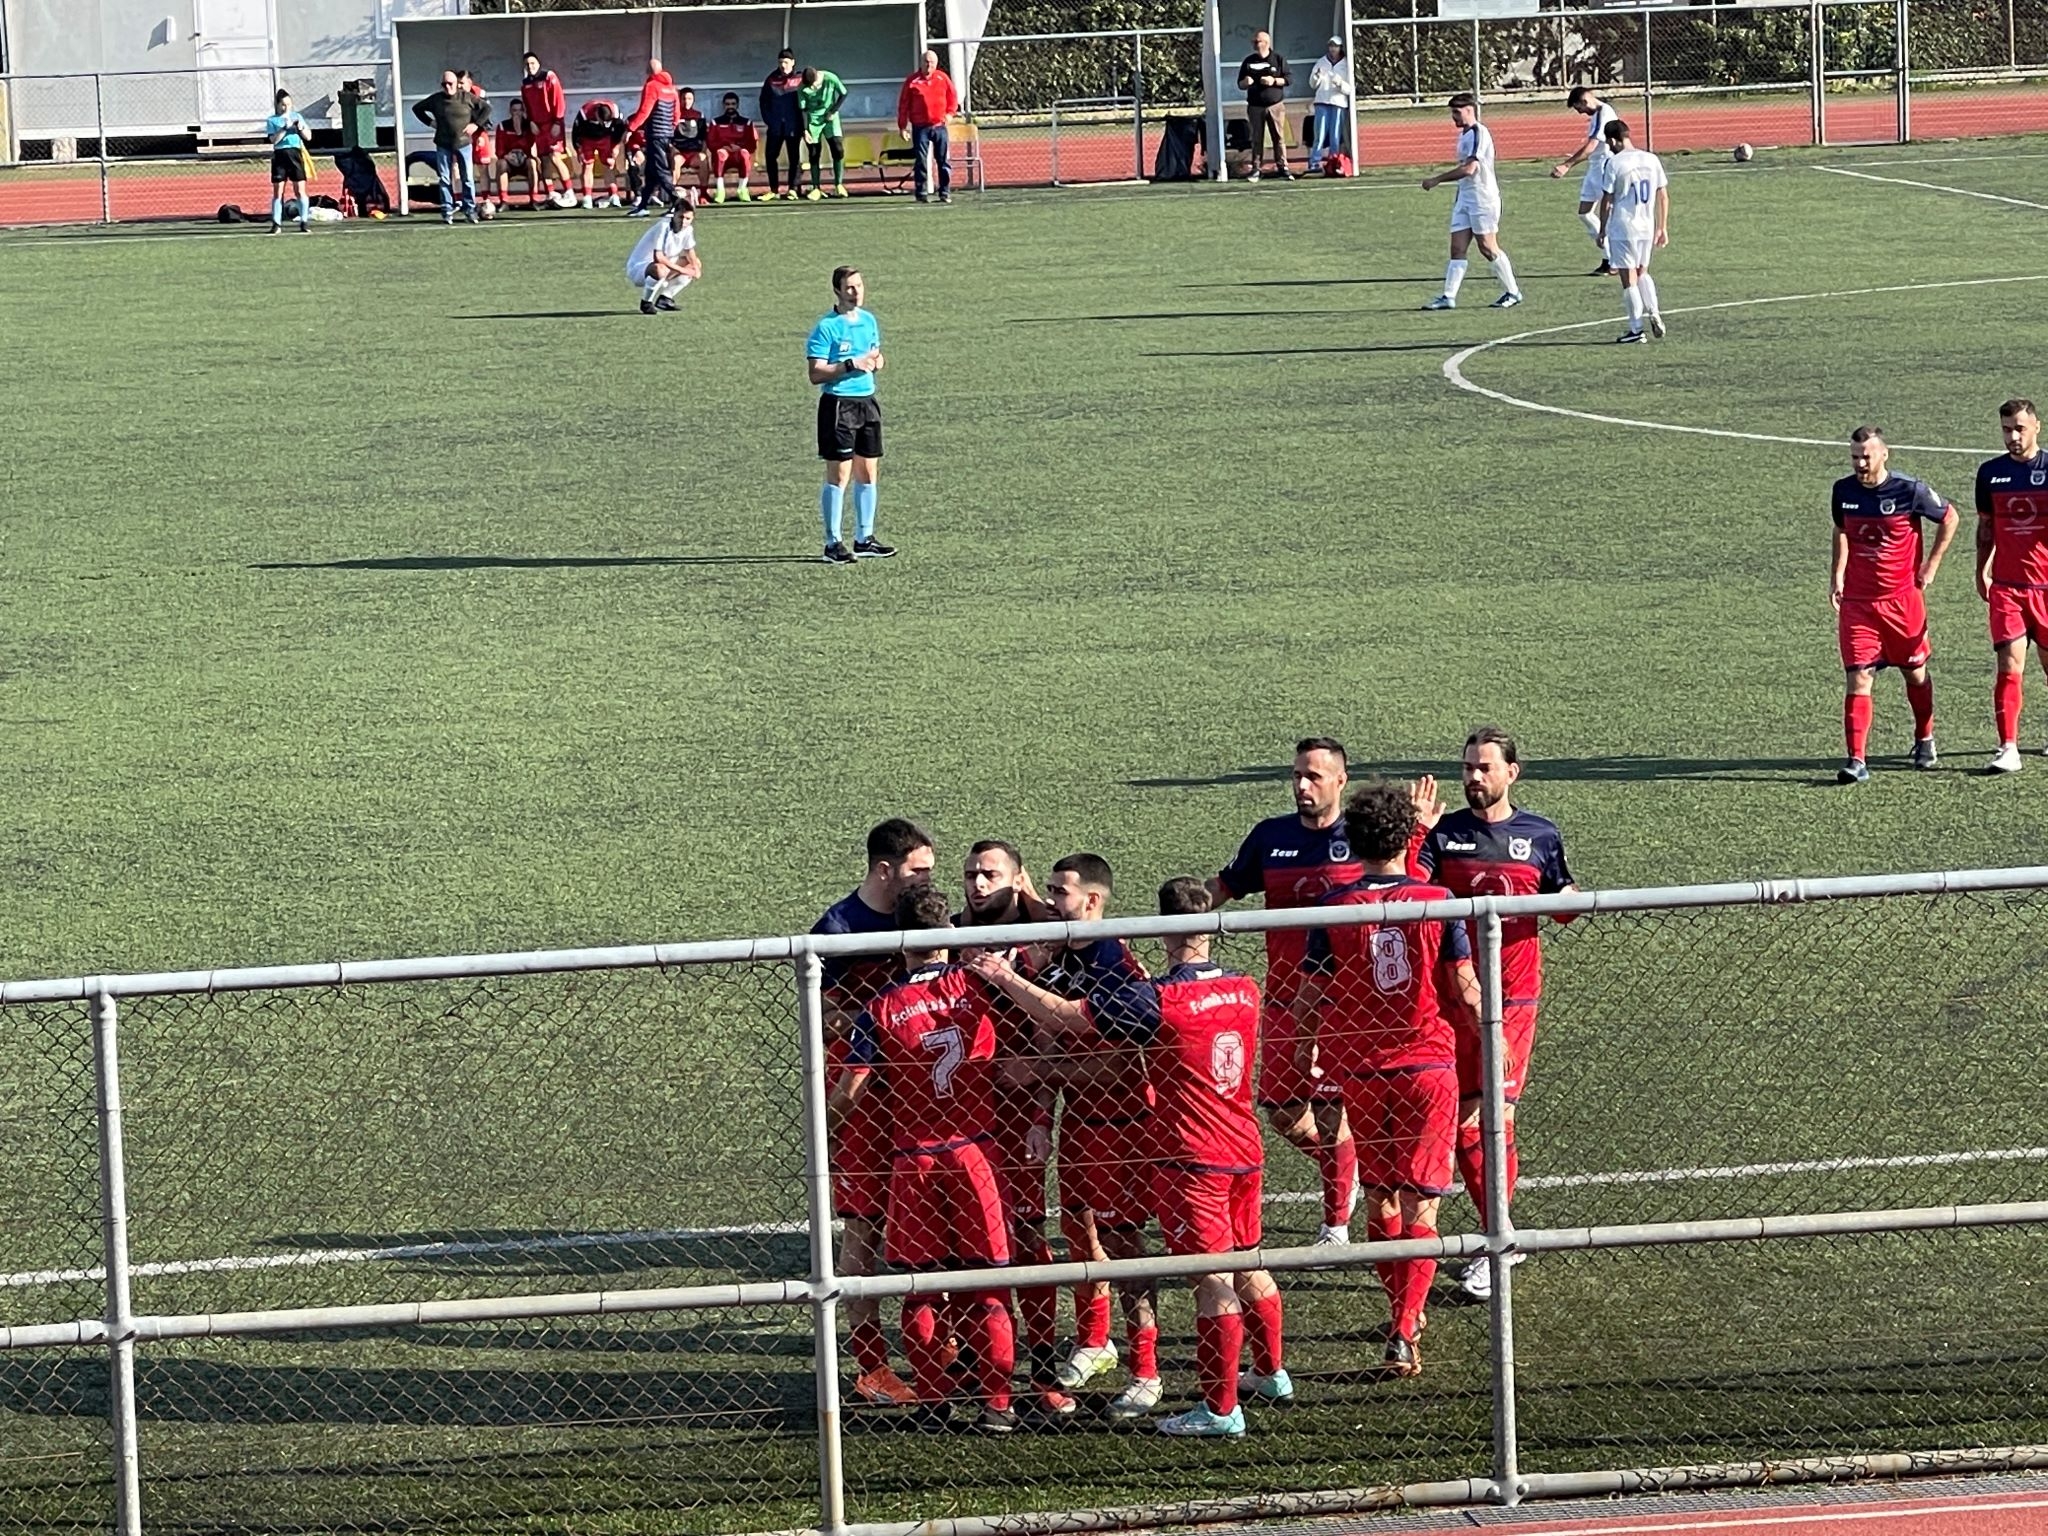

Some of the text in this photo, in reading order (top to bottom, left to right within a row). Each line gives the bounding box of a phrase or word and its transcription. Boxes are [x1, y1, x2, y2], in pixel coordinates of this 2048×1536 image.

[1630, 179, 1650, 205] 10
[1270, 848, 1299, 858] Zeus
[1445, 840, 1477, 851] Zeus
[1369, 926, 1413, 995] 8
[919, 1025, 966, 1100] 7
